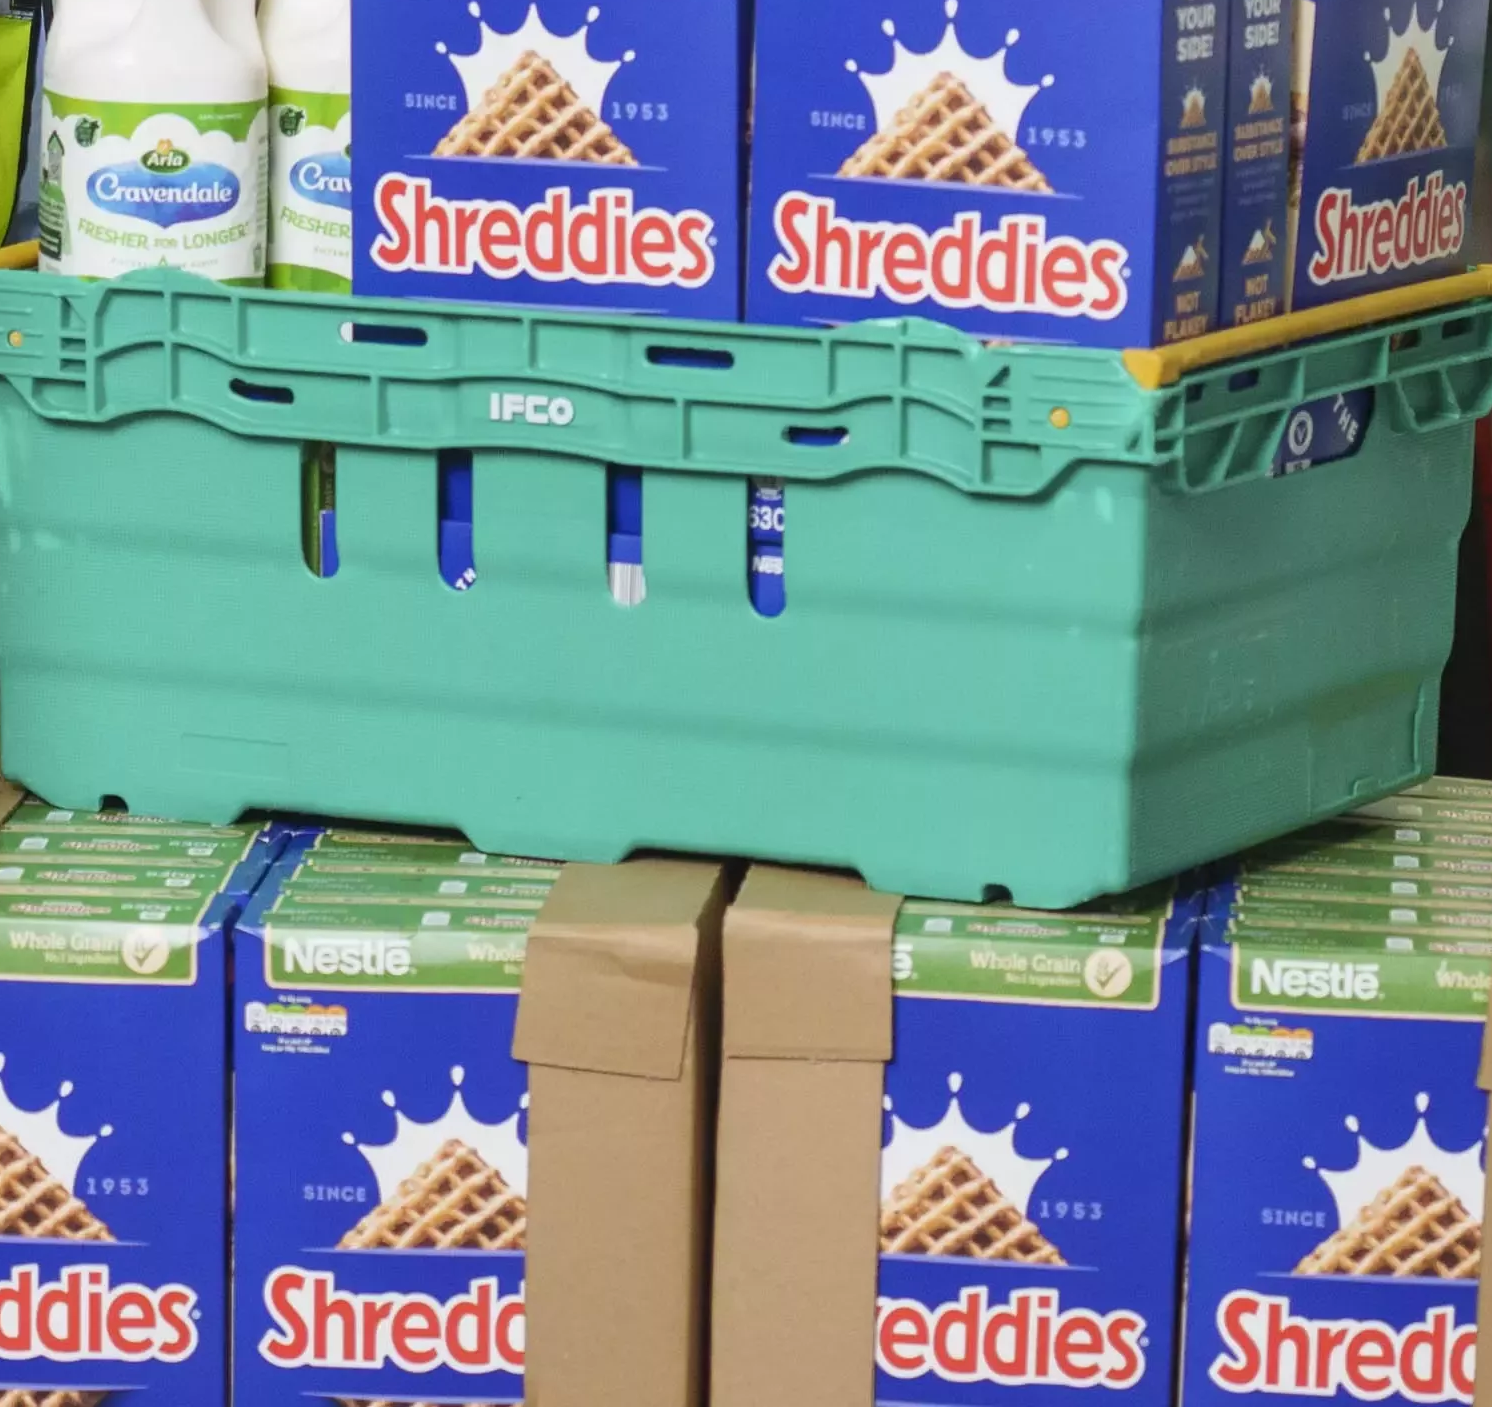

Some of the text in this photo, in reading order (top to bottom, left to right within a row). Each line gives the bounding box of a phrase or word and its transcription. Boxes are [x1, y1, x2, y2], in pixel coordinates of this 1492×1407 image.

[1176, 3, 1216, 31] YOUR
[1176, 35, 1214, 63] SIDE!
[404, 93, 669, 122] SINCE 1953
[810, 110, 1088, 149] SINCE 1953
[146, 153, 184, 168] Arla
[95, 172, 232, 204] Cravendale
[77, 217, 150, 250] FRESHER
[153, 237, 178, 248] FOR
[280, 205, 351, 239] FRESHER
[373, 175, 711, 285] Shreddies
[1311, 172, 1466, 282] Shreddies
[771, 194, 1124, 316] Shreddies
[1245, 274, 1269, 298] NOT
[488, 392, 576, 427] IFCO
[1331, 393, 1360, 444] THE
[9, 929, 121, 952] Whole Grain
[283, 937, 412, 976] Nestlé
[969, 949, 1082, 974] Whole Grain
[1250, 957, 1382, 1003] Nestlé
[86, 1176, 150, 1197] 1953
[302, 1185, 367, 1204] SINCE
[1038, 1199, 1104, 1221] 1953
[1260, 1207, 1327, 1229] SINCE
